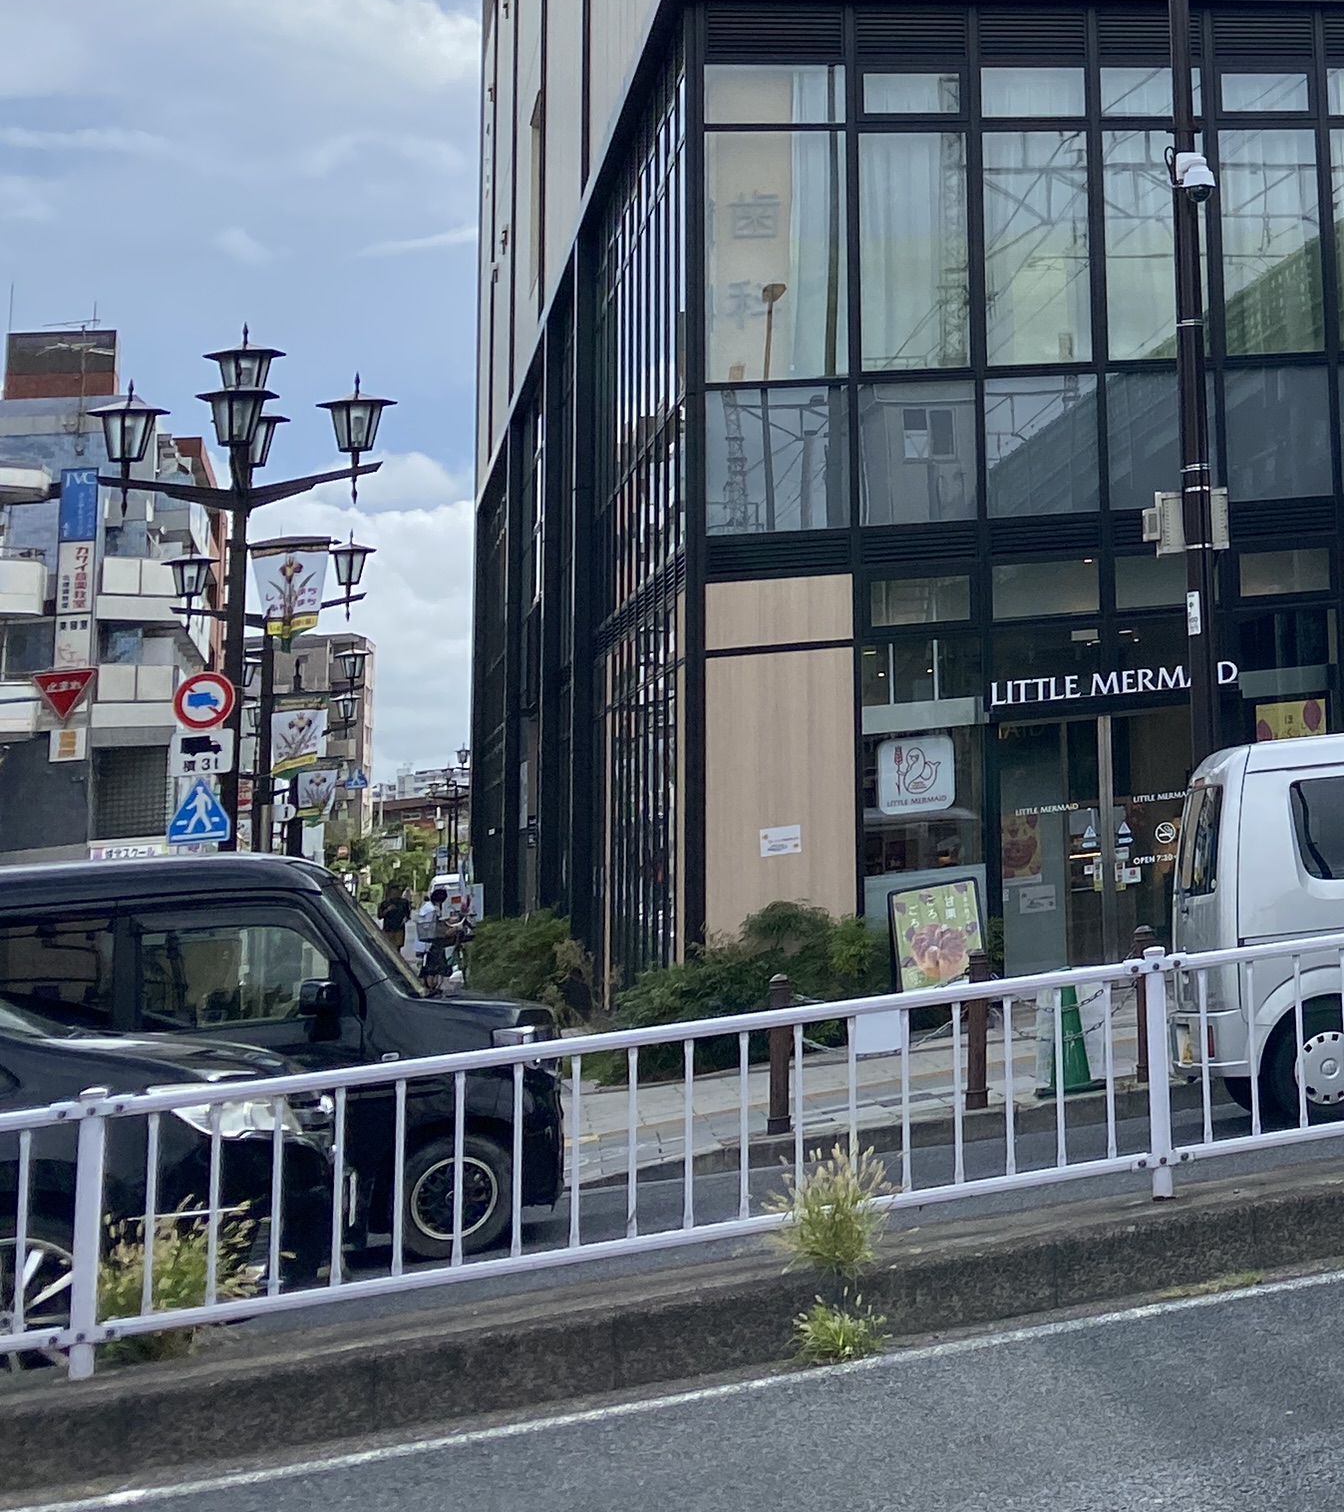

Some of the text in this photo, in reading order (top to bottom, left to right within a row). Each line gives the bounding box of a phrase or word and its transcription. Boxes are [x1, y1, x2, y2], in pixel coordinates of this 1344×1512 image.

[65, 471, 96, 488] JVC
[990, 660, 1239, 706] LITTLE MERMD
[886, 794, 947, 808] LITTLE MERMAID
[1132, 790, 1190, 804] LITTLE MERMA
[1015, 802, 1079, 817] LITTLE MERMAID
[1132, 855, 1156, 866] OPEN
